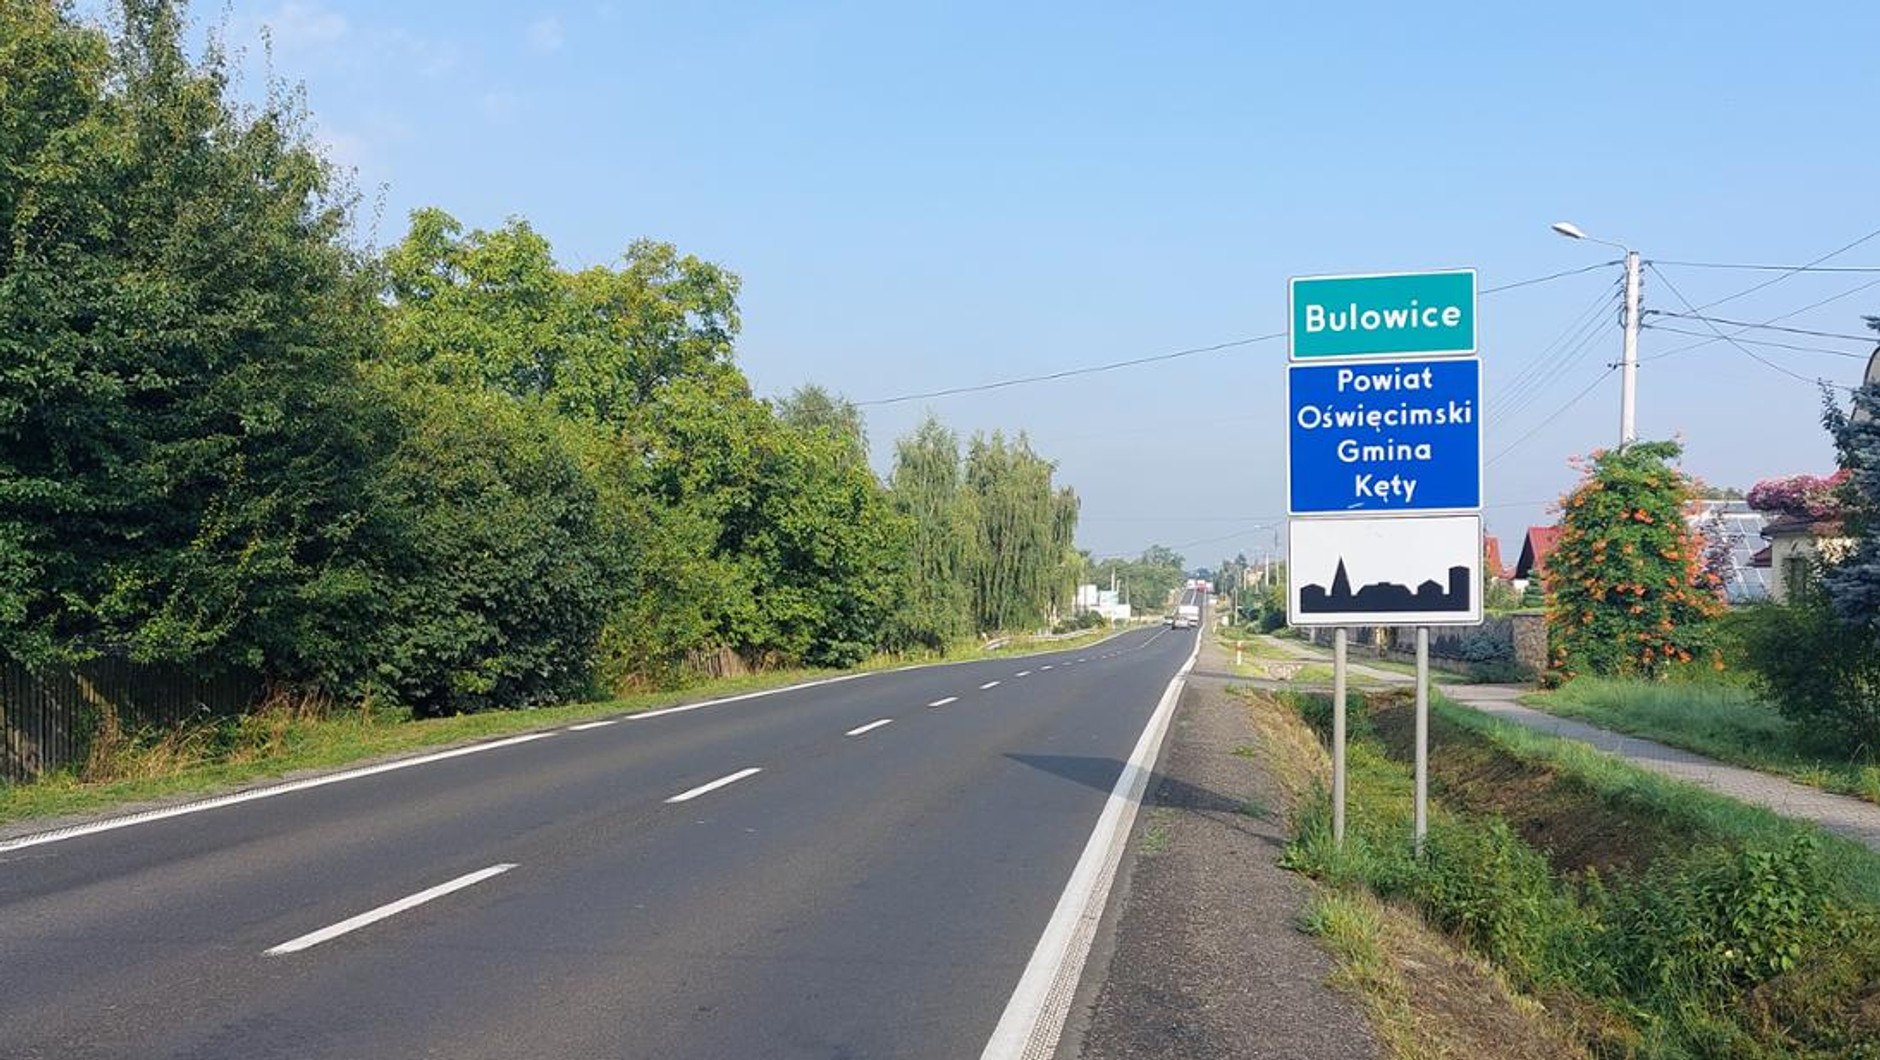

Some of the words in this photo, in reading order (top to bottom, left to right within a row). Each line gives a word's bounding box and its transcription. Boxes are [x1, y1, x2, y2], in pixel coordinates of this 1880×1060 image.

[1305, 300, 1461, 333] Bulowice
[1338, 367, 1433, 392] Powiat
[1297, 400, 1471, 431] Oświęcimski
[1337, 438, 1432, 463] Gmina
[1355, 473, 1417, 502] Kęty
